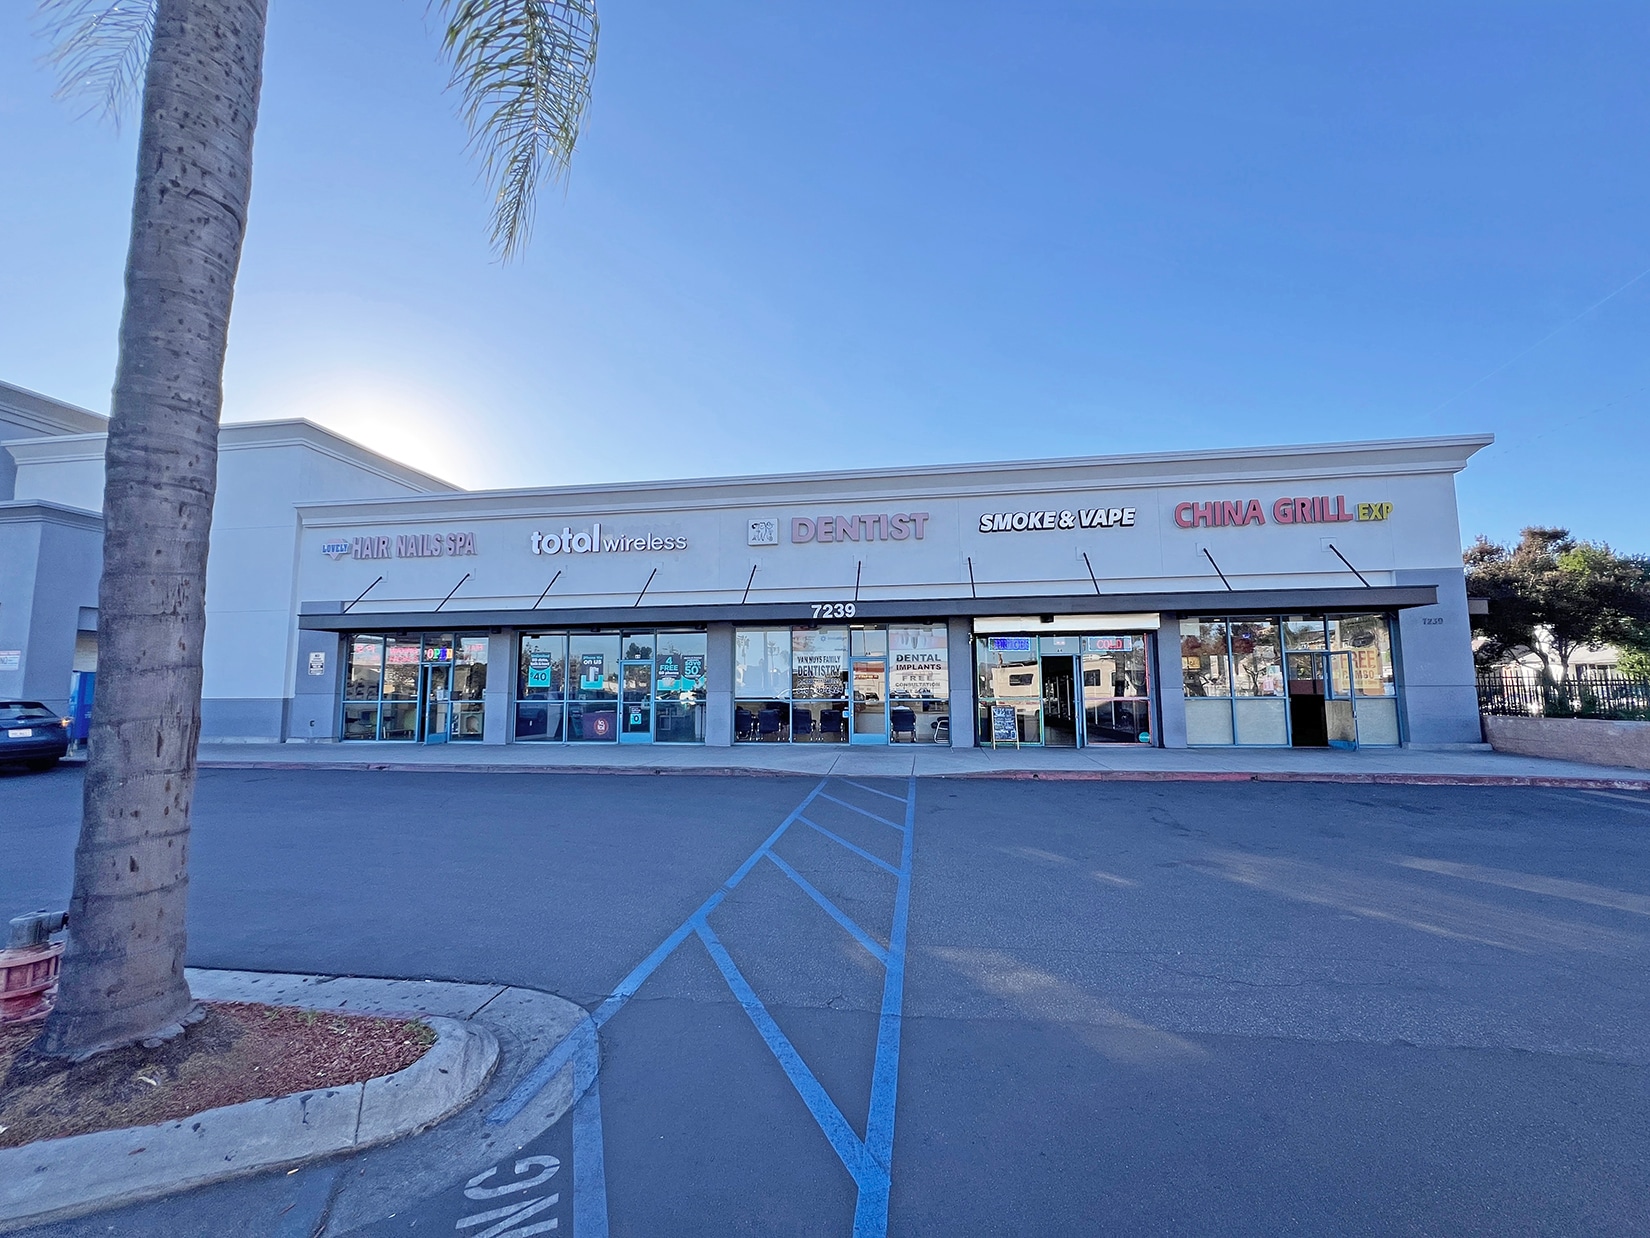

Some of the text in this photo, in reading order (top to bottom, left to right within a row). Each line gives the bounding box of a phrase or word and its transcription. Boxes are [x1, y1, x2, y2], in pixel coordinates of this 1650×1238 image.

[979, 507, 1136, 533] SMOKE & VAPE
[1174, 495, 1393, 528] CHINA GRILL EXP
[530, 523, 688, 555] total wireless
[791, 512, 930, 543] DENTIST
[322, 532, 478, 560] LOVELY HAIR NAILS SPA
[811, 603, 856, 619] 7239
[665, 656, 673, 664] 4
[797, 665, 841, 677] DENTISTRY
[896, 654, 942, 662] DENTAL
